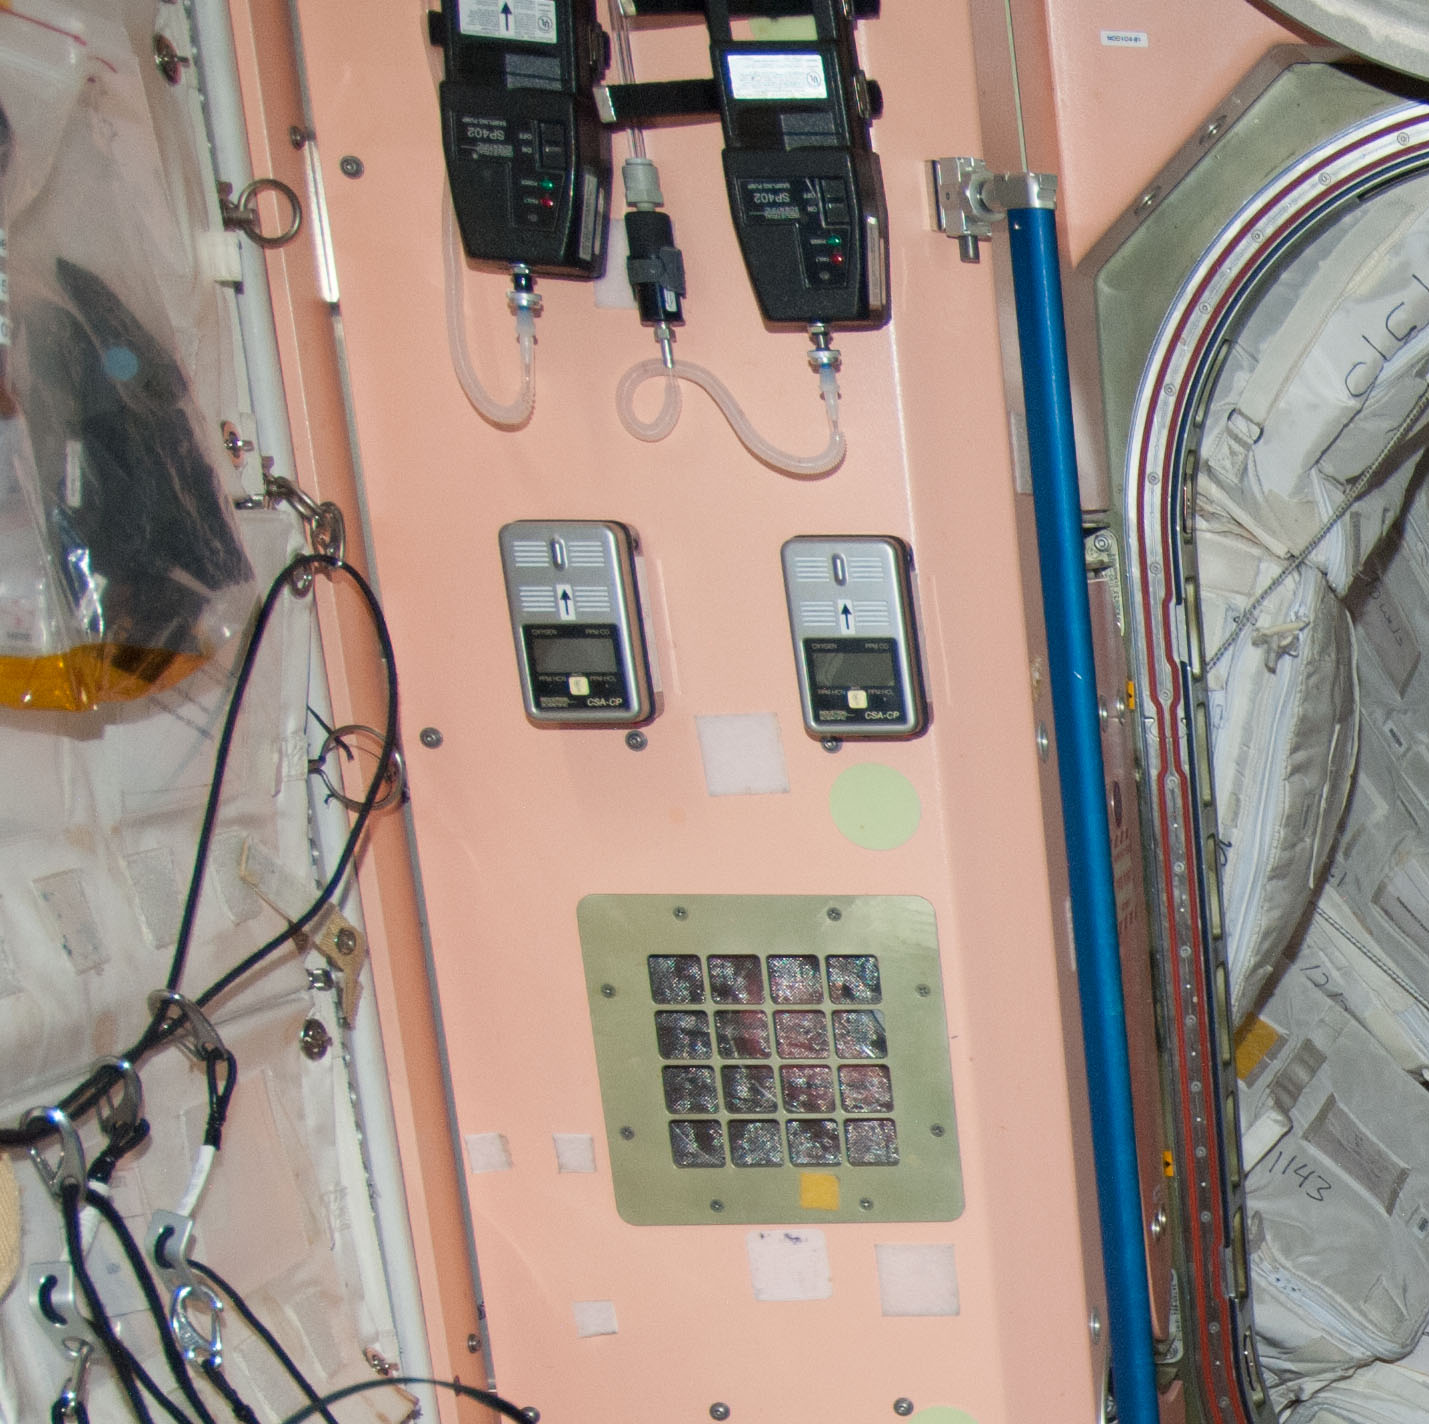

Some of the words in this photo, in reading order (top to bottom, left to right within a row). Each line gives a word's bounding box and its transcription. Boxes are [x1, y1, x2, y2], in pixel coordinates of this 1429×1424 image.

[467, 127, 505, 141] SP402
[752, 192, 790, 204] SP402
[587, 698, 623, 707] CSA-CP
[864, 711, 900, 720] CSA-CP
[1268, 1151, 1332, 1202] 1143
